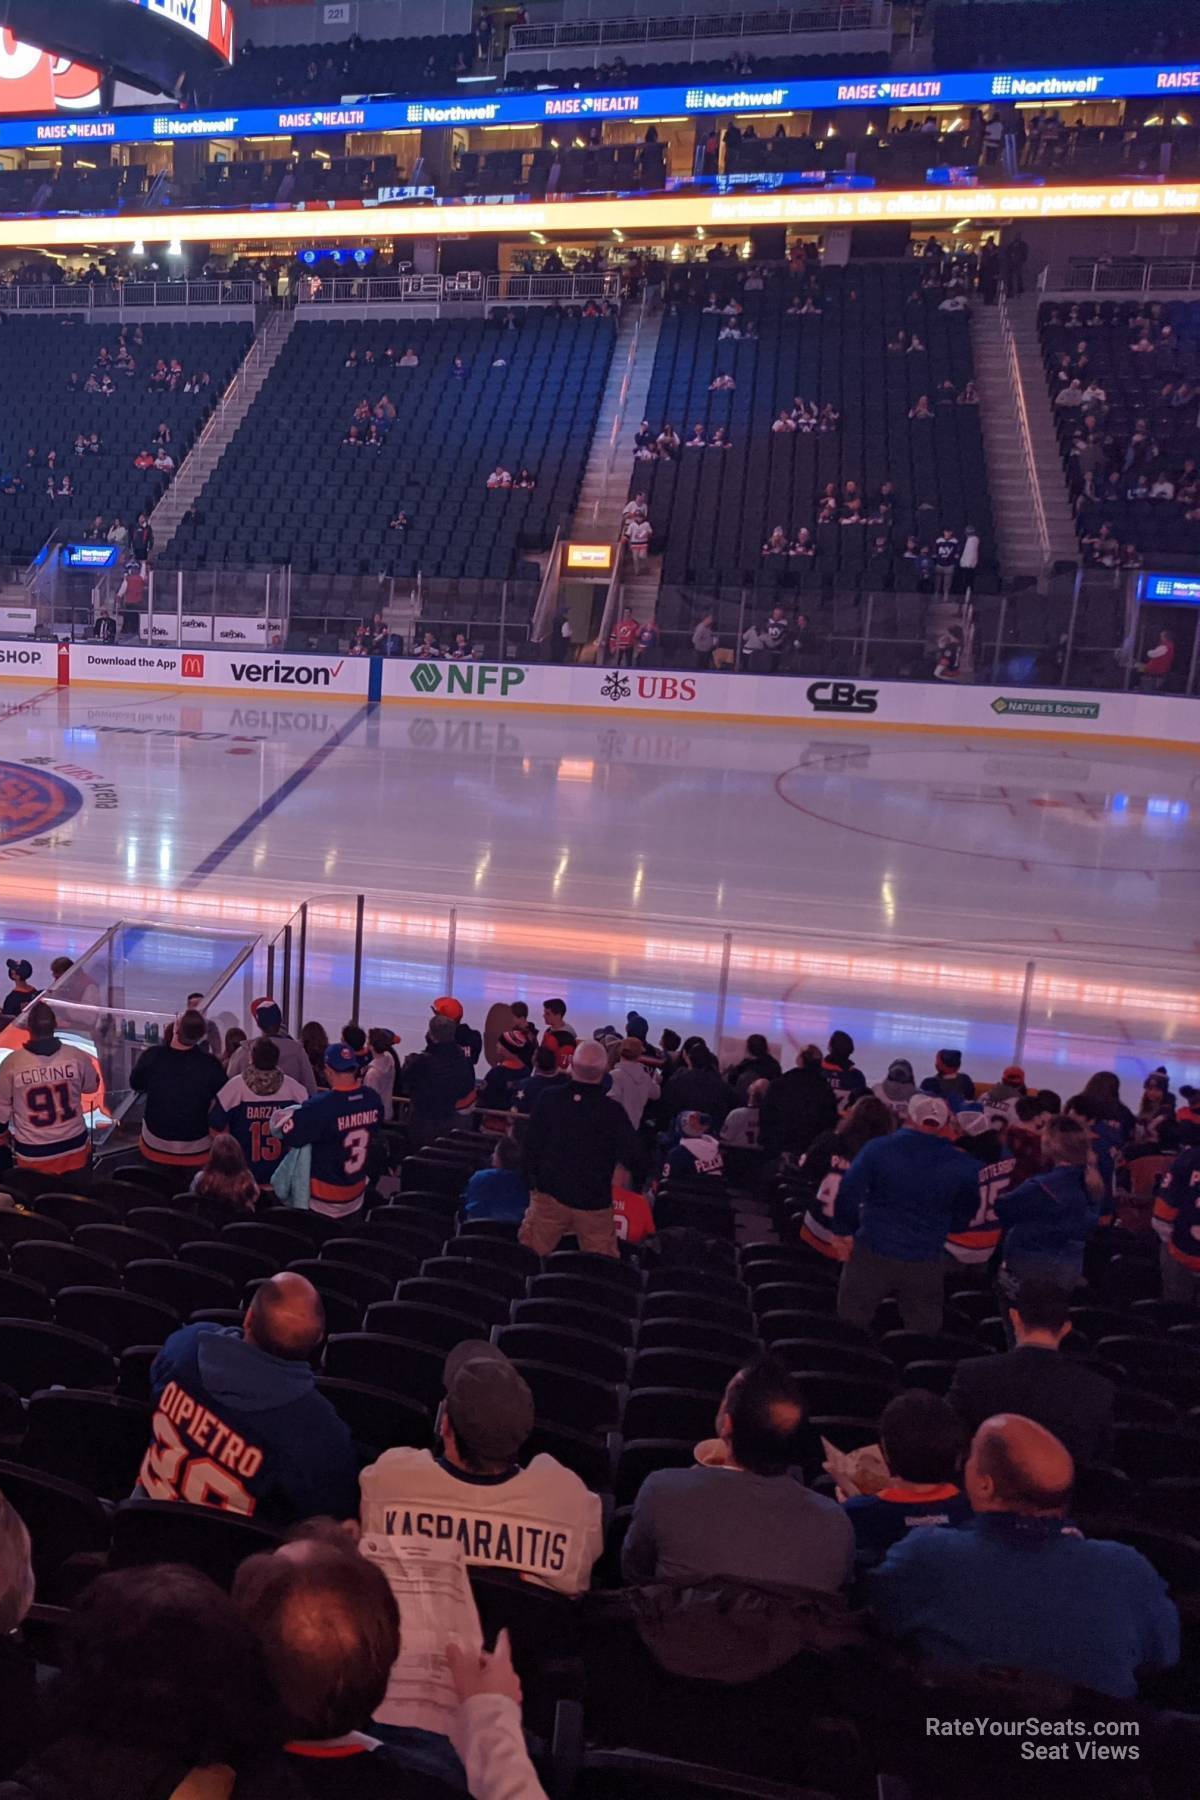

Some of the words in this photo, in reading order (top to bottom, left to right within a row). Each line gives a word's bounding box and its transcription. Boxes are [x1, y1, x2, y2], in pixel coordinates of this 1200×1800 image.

[328, 9, 344, 20] 221
[838, 84, 877, 100] RAISE
[890, 81, 942, 98] HEALTH
[1011, 77, 1098, 95] Northwell
[545, 99, 580, 114] RAISE
[593, 96, 639, 111] HEALTH
[703, 90, 783, 108] Northwell
[279, 113, 312, 128] RAISE
[322, 110, 364, 125] HEALTH
[423, 104, 496, 122] Northwell
[37, 125, 67, 139] RAISE
[76, 123, 115, 137] HEALTH
[169, 118, 234, 134] Northwell
[87, 655, 138, 668] Download
[139, 657, 155, 668] the
[156, 658, 177, 671] App
[230, 660, 330, 686] verizon
[446, 664, 525, 696] NFP
[637, 675, 697, 701] UBS
[806, 681, 880, 714] CBS
[87, 782, 119, 810] Arena
[21, 1064, 75, 1086] GORING
[27, 1083, 77, 1128] 91
[337, 1110, 379, 1132] HAMONIC
[249, 1120, 282, 1163] 13
[343, 1128, 370, 1175] 3
[158, 1380, 264, 1478] DIPIETRO
